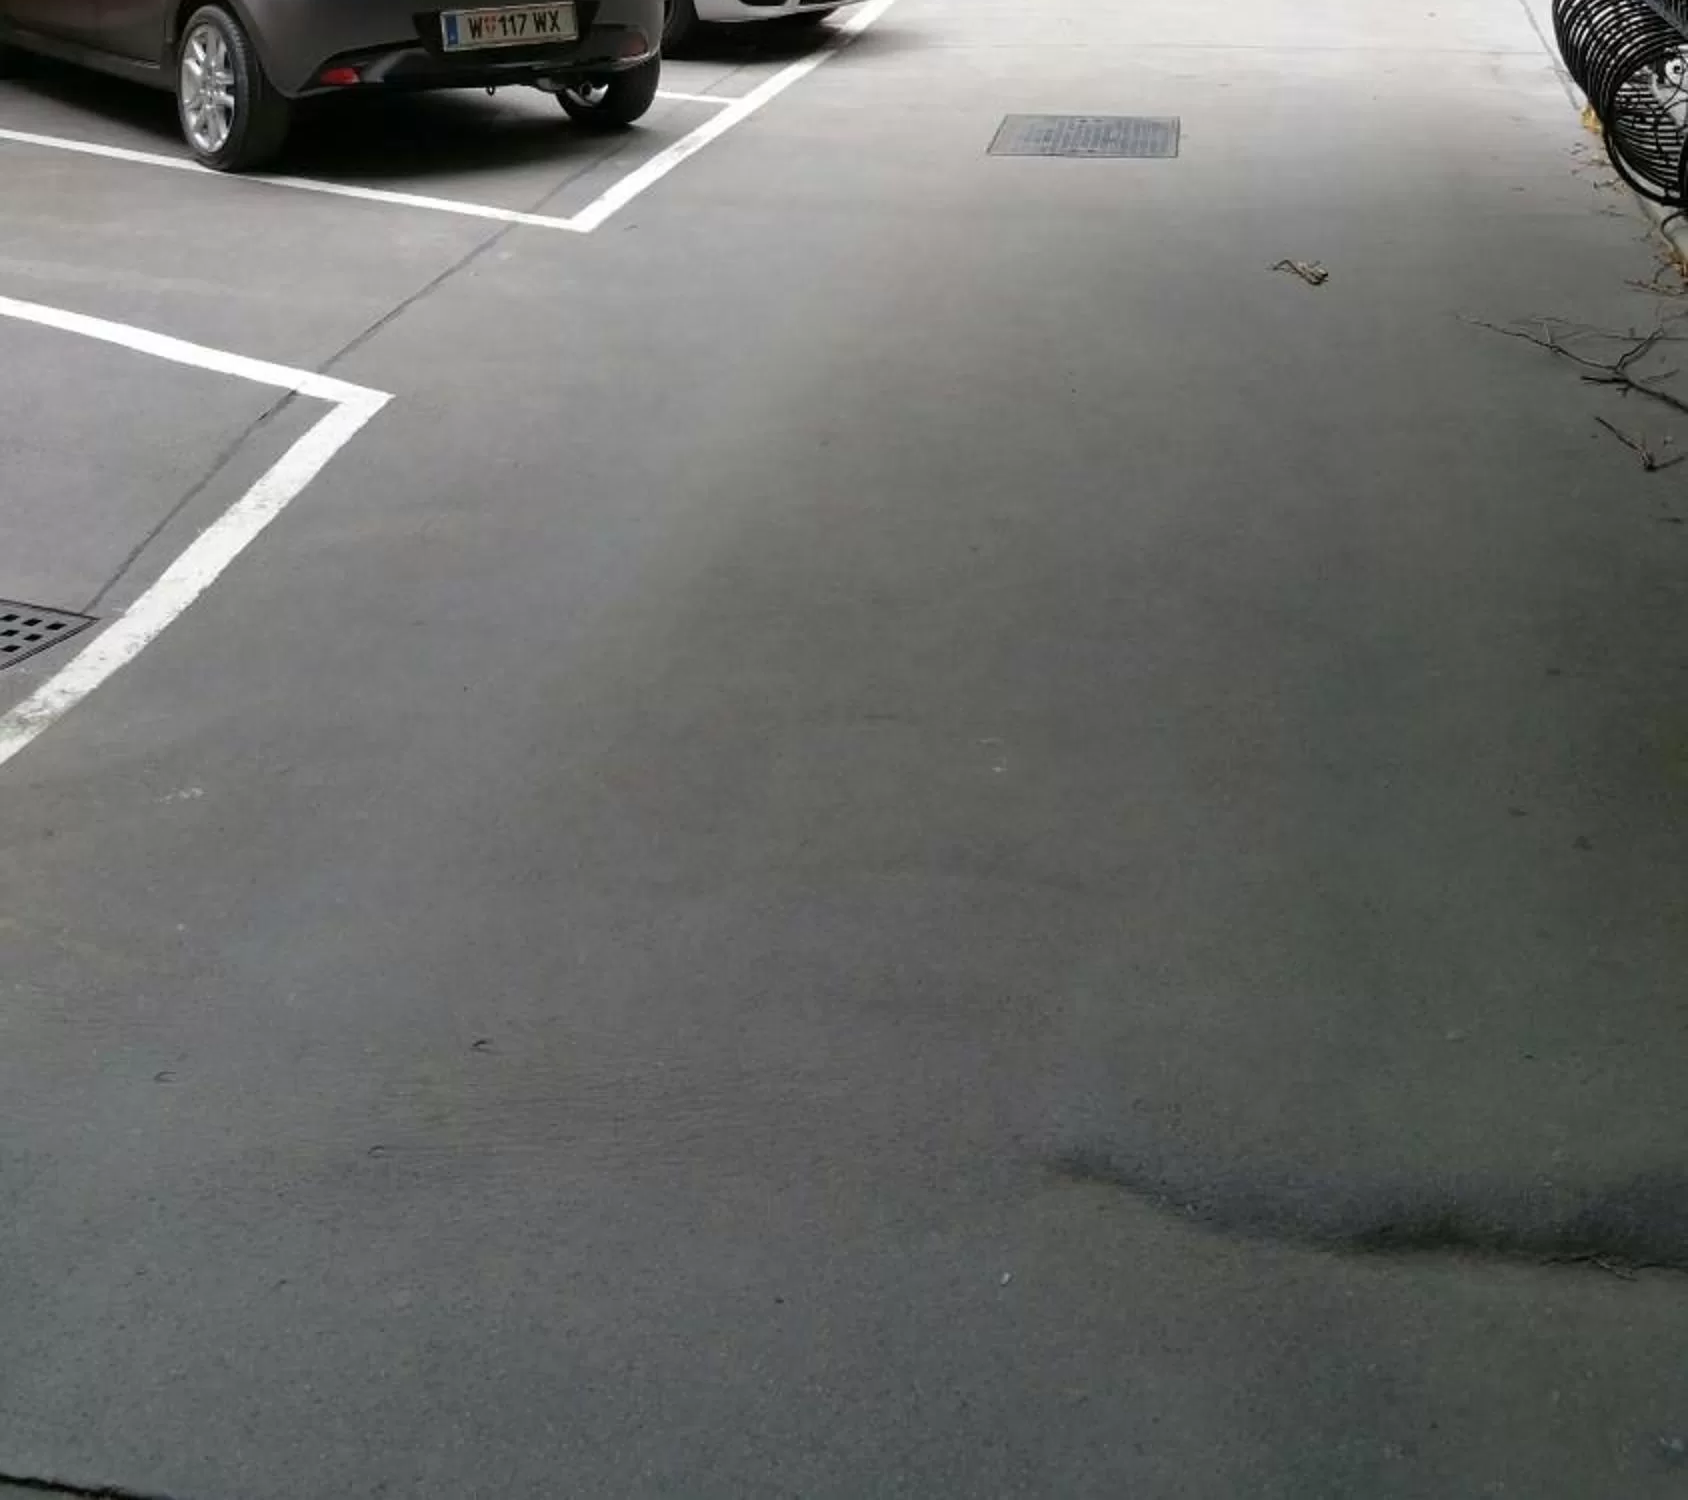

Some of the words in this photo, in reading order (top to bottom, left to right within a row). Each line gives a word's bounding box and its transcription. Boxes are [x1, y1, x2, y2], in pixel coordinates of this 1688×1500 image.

[467, 16, 483, 40] W
[498, 13, 528, 37] 117
[532, 9, 561, 34] WX
